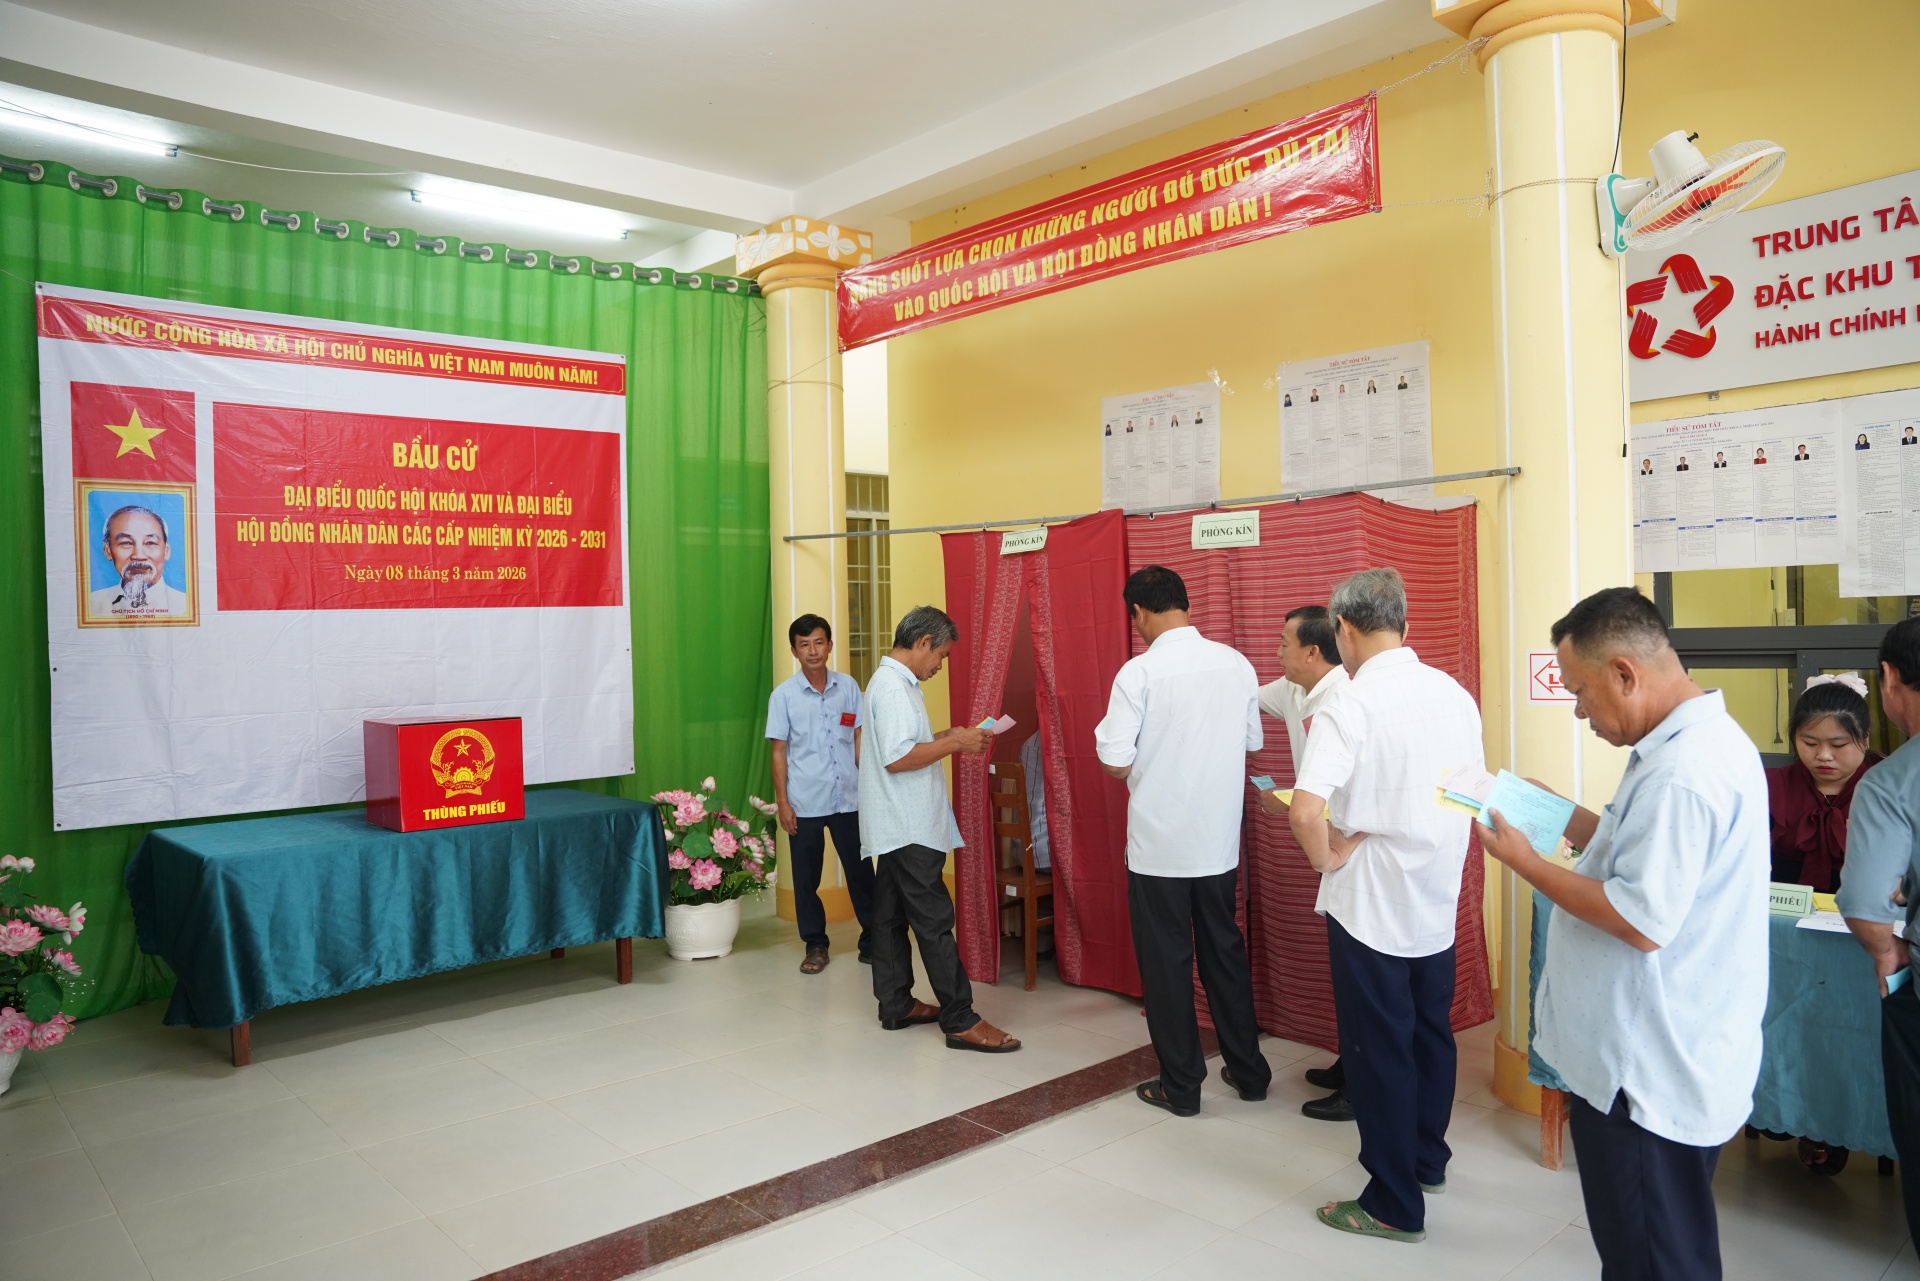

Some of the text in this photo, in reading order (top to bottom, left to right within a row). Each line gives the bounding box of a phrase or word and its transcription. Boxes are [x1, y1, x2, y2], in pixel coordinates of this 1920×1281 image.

[891, 259, 931, 290] SUỐT
[935, 248, 965, 278] LỰA
[968, 231, 1017, 262] CHỌN
[1021, 209, 1086, 249] NHỮNG
[1091, 185, 1158, 226] NGƯỜI
[1163, 169, 1194, 203] ĐỦ
[1306, 126, 1350, 160] TÀI
[1752, 215, 1861, 258] TRUNG
[894, 293, 925, 322] VÀO
[928, 278, 973, 313] QUỐC
[977, 268, 1009, 298] HỘI
[1012, 258, 1037, 287] VÀ
[1041, 248, 1075, 279] HỘI
[1080, 231, 1137, 268] ĐỒNG
[1142, 211, 1203, 250] NHÂN
[1210, 197, 1259, 232] DÂN
[1754, 273, 1815, 310] ĐẶC
[1825, 260, 1894, 296] KHU
[1755, 322, 1820, 349] HÀNH
[1829, 306, 1907, 337] CHÍNH
[86, 314, 598, 385] NƯỚC CỘNG HÒA XÃ HỘI CHỦ NGHĨA VIỆT NAM MUÔN NĂM!
[392, 435, 478, 472] BẦU CỬ
[284, 480, 572, 519] ĐẠI BIỂU QUỐC HỘI KHÓA XVI VÀ ĐẠI BIỂU
[236, 516, 265, 547] HỘI
[270, 515, 314, 544] ĐỒNG
[319, 518, 363, 544] NHÂN
[367, 520, 398, 546] DÂN
[402, 519, 432, 546] CÁC
[436, 519, 464, 546] CẤP
[468, 524, 513, 551] NHIỆM
[516, 524, 533, 548] KỲ
[536, 530, 568, 548] 2026
[580, 531, 606, 549] 2031
[1004, 534, 1044, 549] PHÒNG KÍN
[1200, 523, 1252, 538] PHÒNG KÍN
[344, 564, 527, 583] Ngày 08 tháng 3 năm 2026
[423, 800, 506, 821] THÙNG PHIẾU
